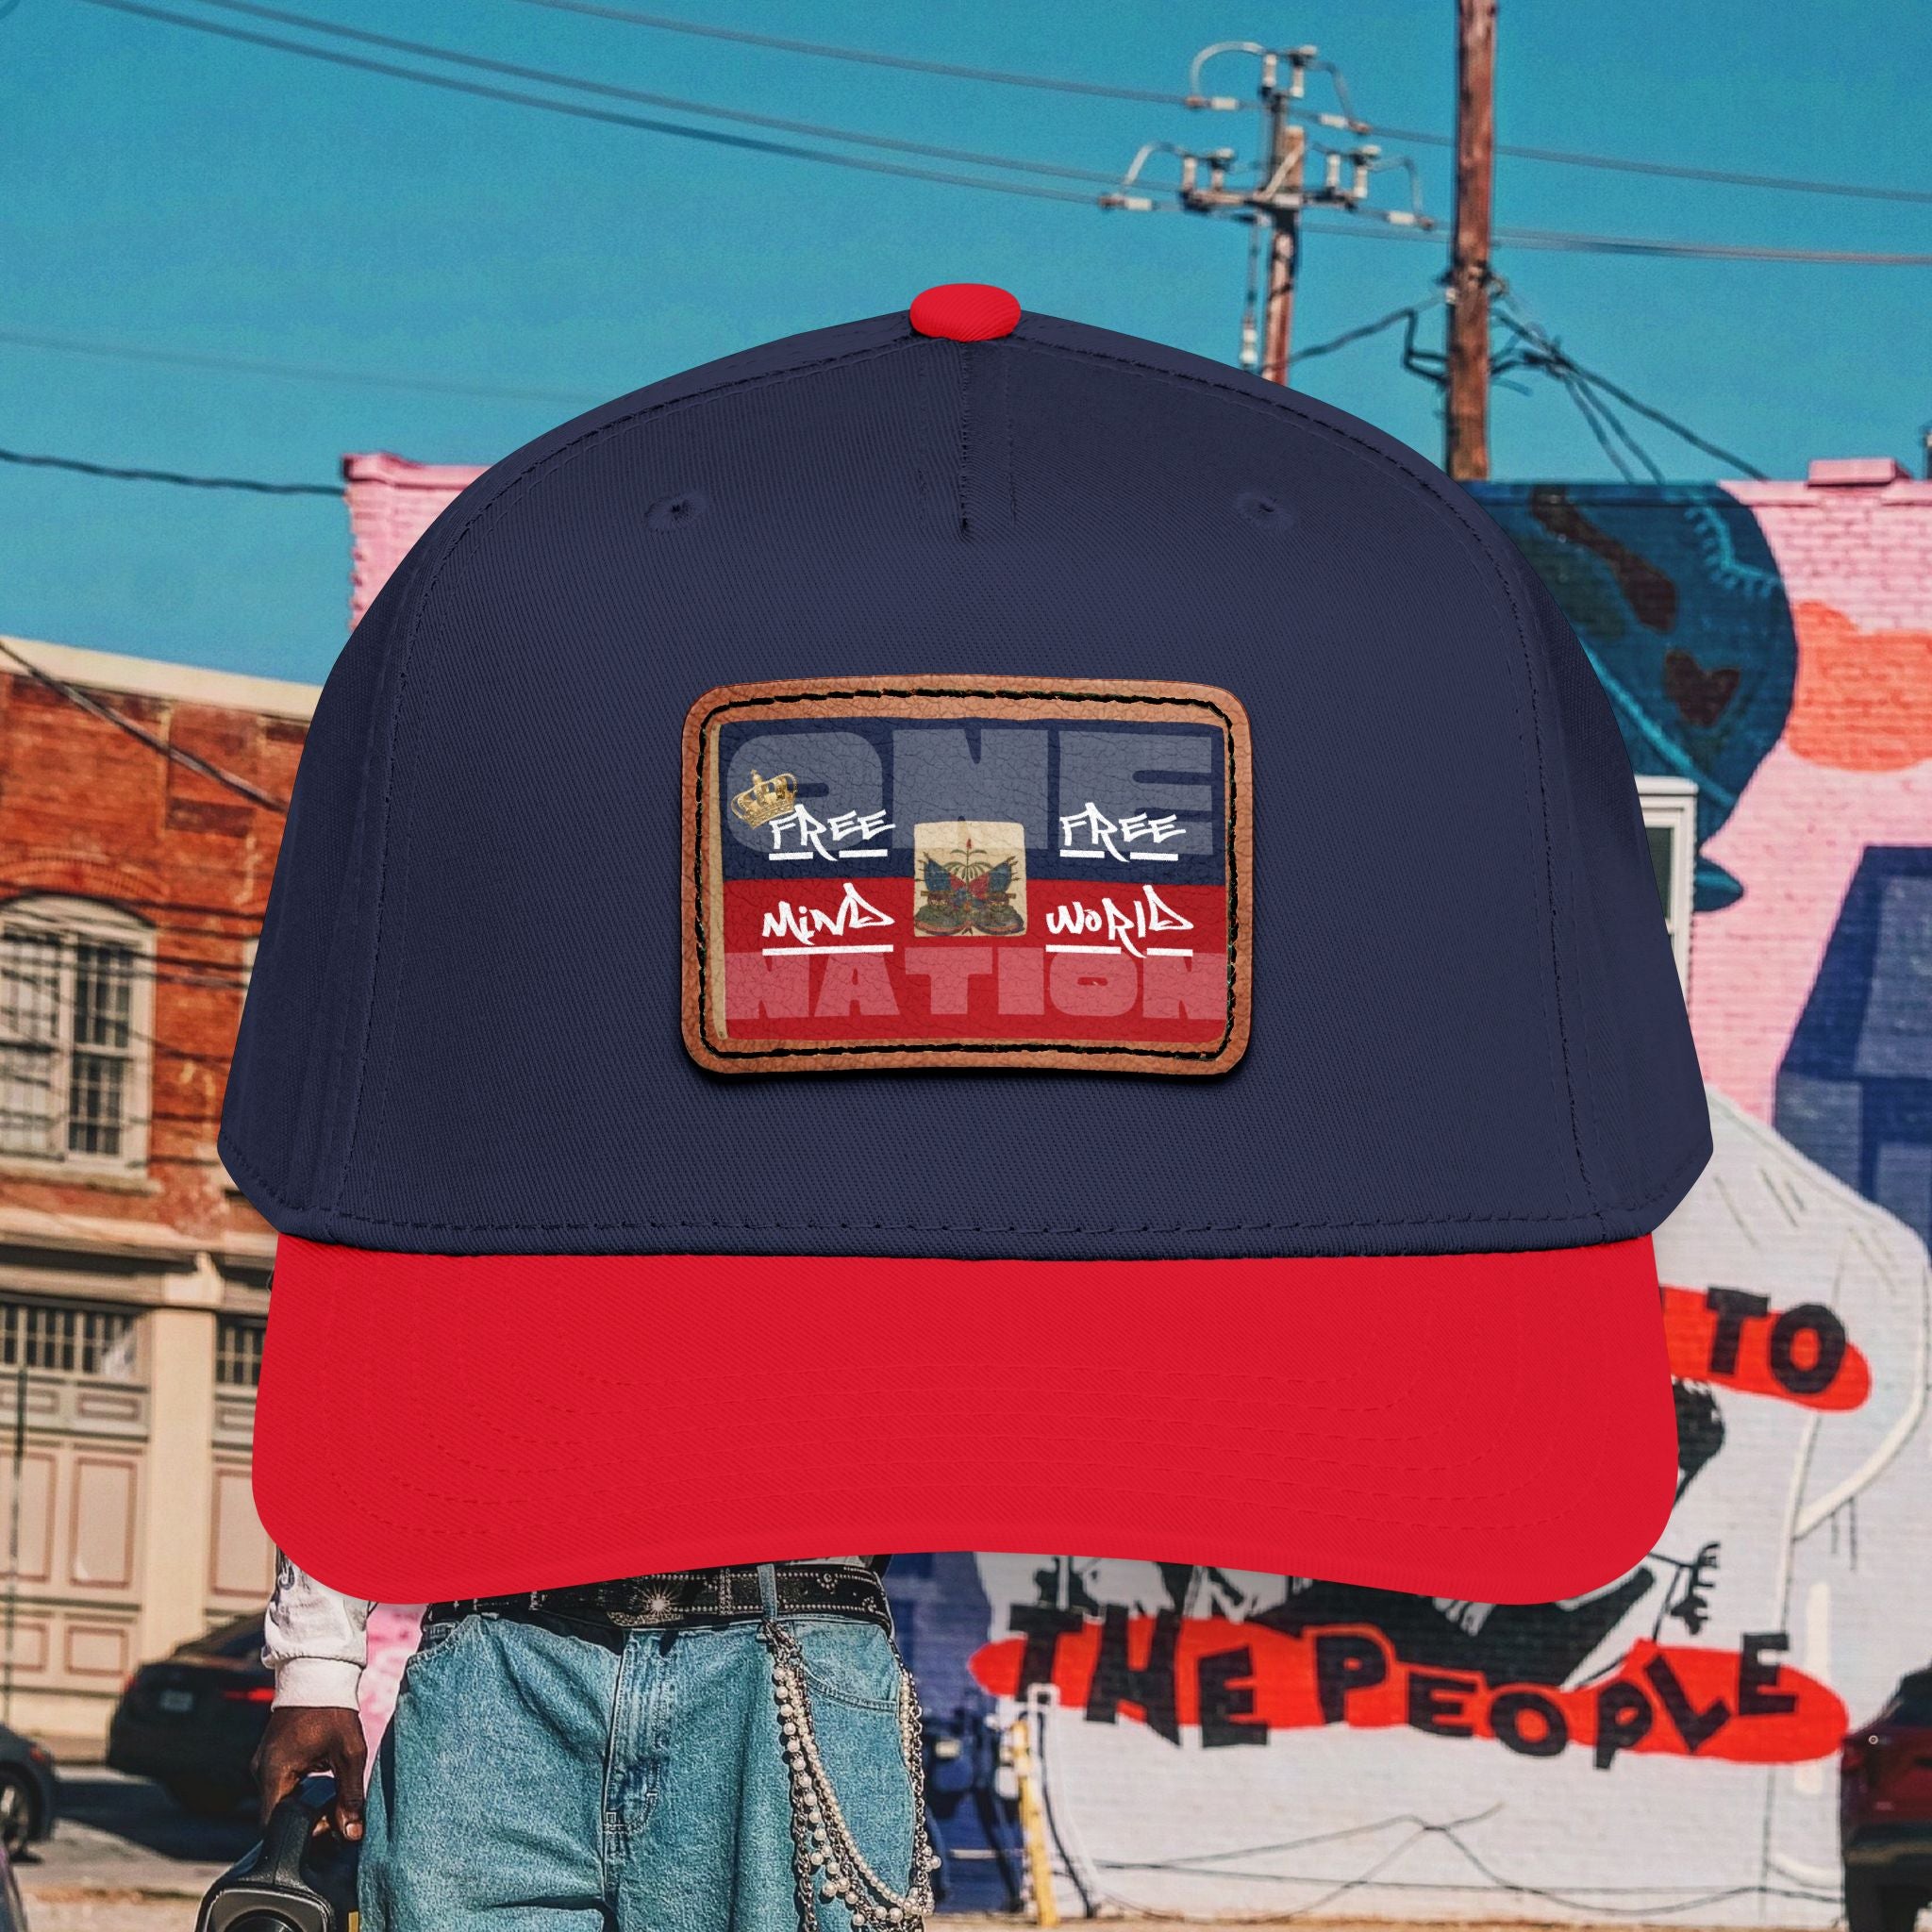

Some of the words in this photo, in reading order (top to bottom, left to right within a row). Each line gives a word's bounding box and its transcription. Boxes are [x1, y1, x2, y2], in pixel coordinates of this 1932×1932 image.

[727, 728, 1214, 857] ONE
[769, 804, 896, 861] FREE
[1059, 803, 1186, 862] FREE
[724, 947, 1225, 1021] NATION
[1707, 1287, 1845, 1394] TO
[1008, 1603, 1270, 1747] THE
[1314, 1633, 1799, 1770] PEOPLE
